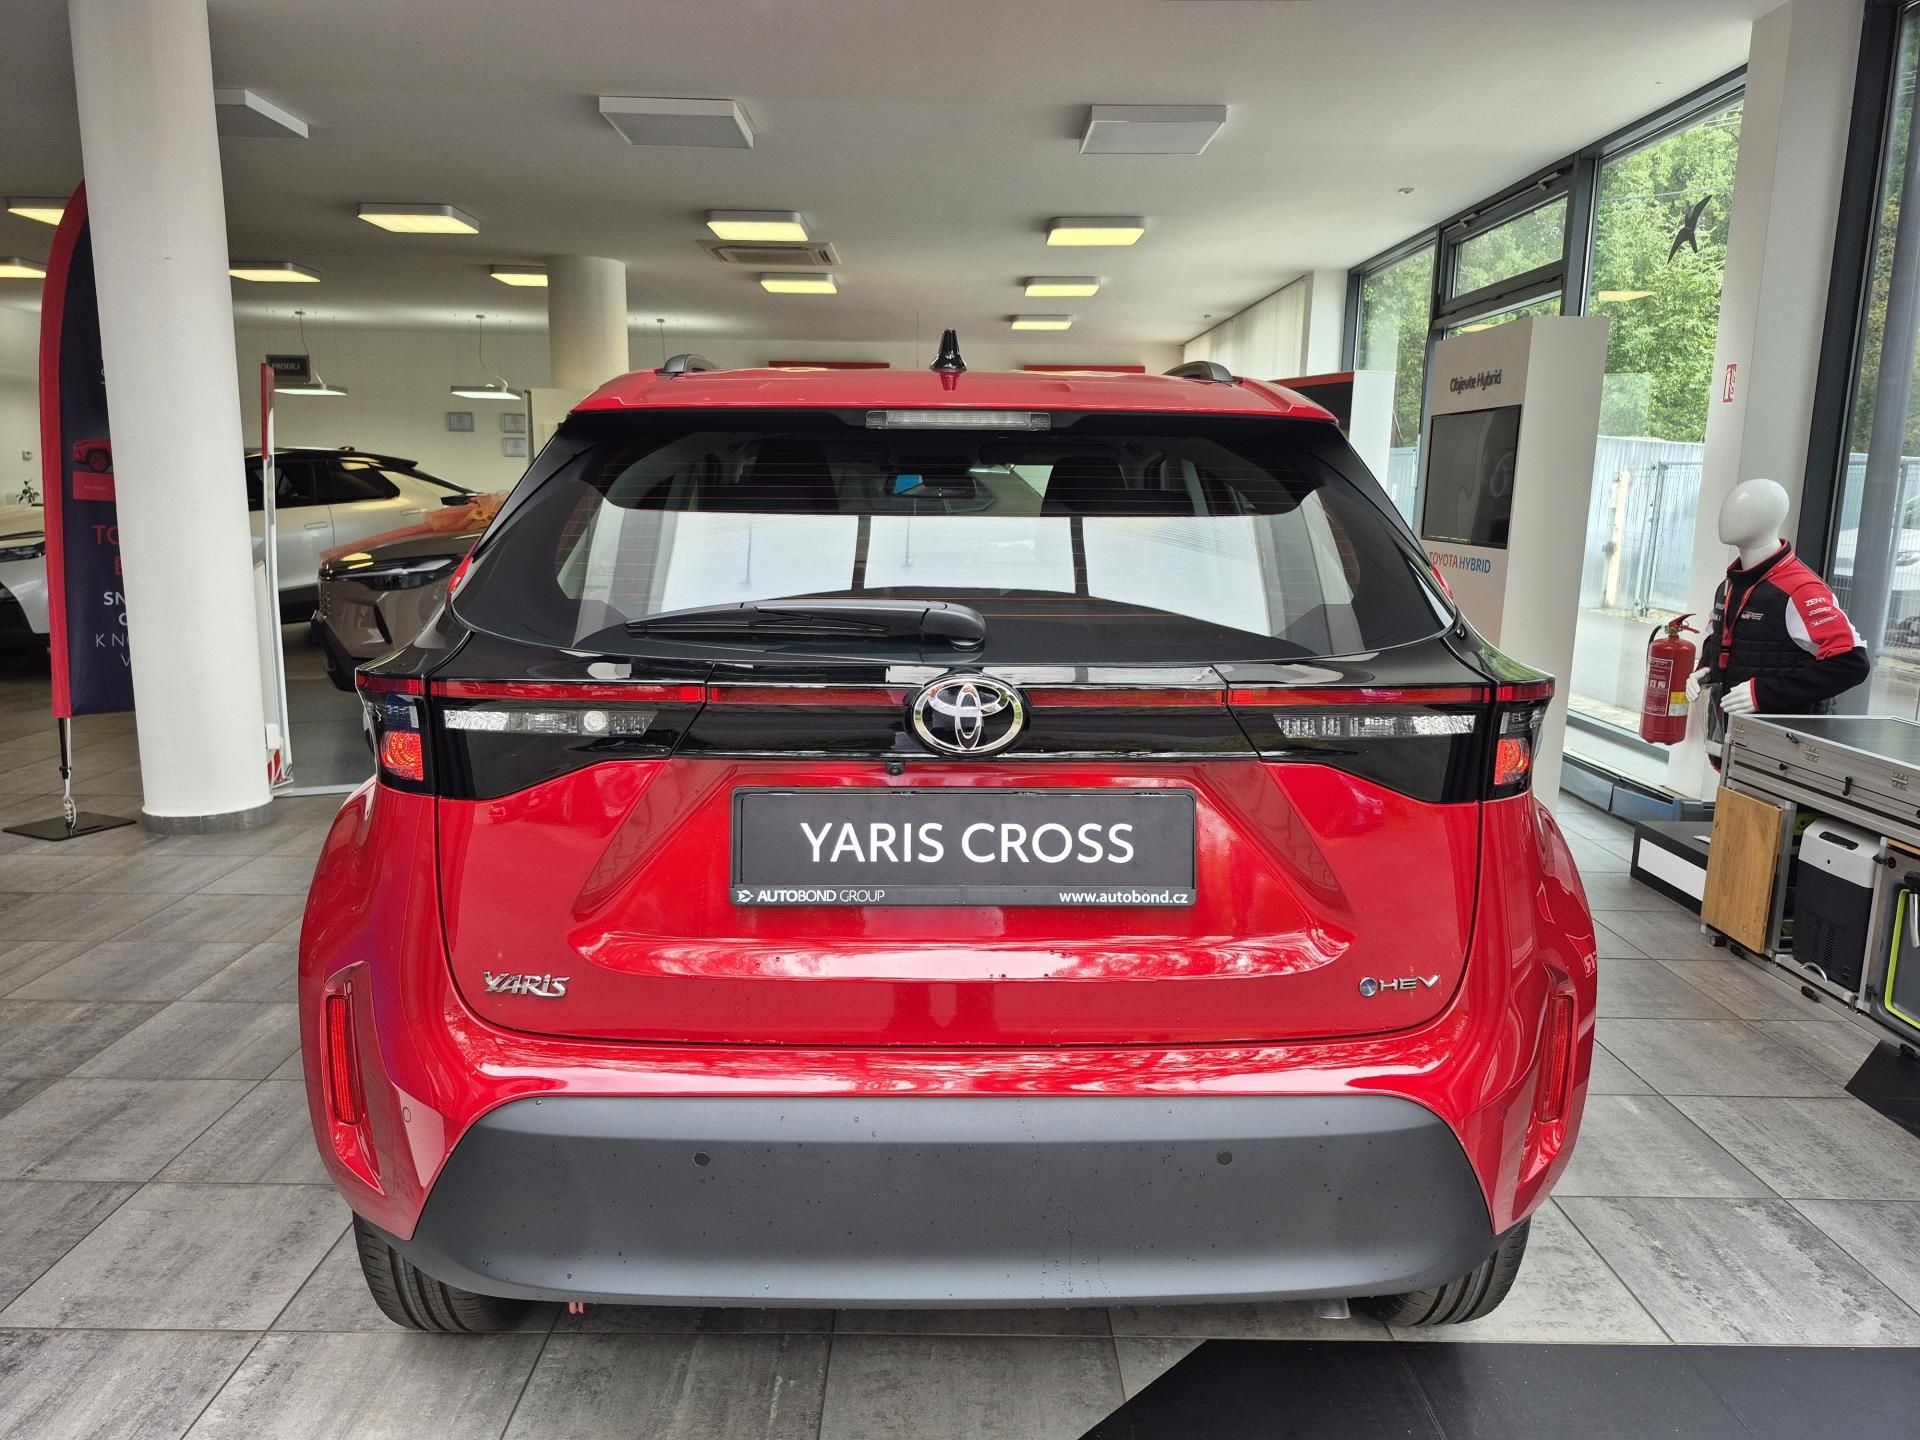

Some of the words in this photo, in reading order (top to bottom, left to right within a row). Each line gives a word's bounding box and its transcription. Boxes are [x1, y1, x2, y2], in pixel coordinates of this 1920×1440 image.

[1428, 551, 1458, 568] TOYOTA
[1459, 556, 1491, 574] HYBRID
[799, 822, 944, 863] YARIS
[961, 822, 1135, 864] CROSS
[757, 889, 836, 903] AUTOBOND
[839, 889, 886, 903] GROUP
[1059, 889, 1189, 904] www.autobond.cz
[483, 971, 571, 997] YARIS
[1379, 974, 1441, 992] HEV
